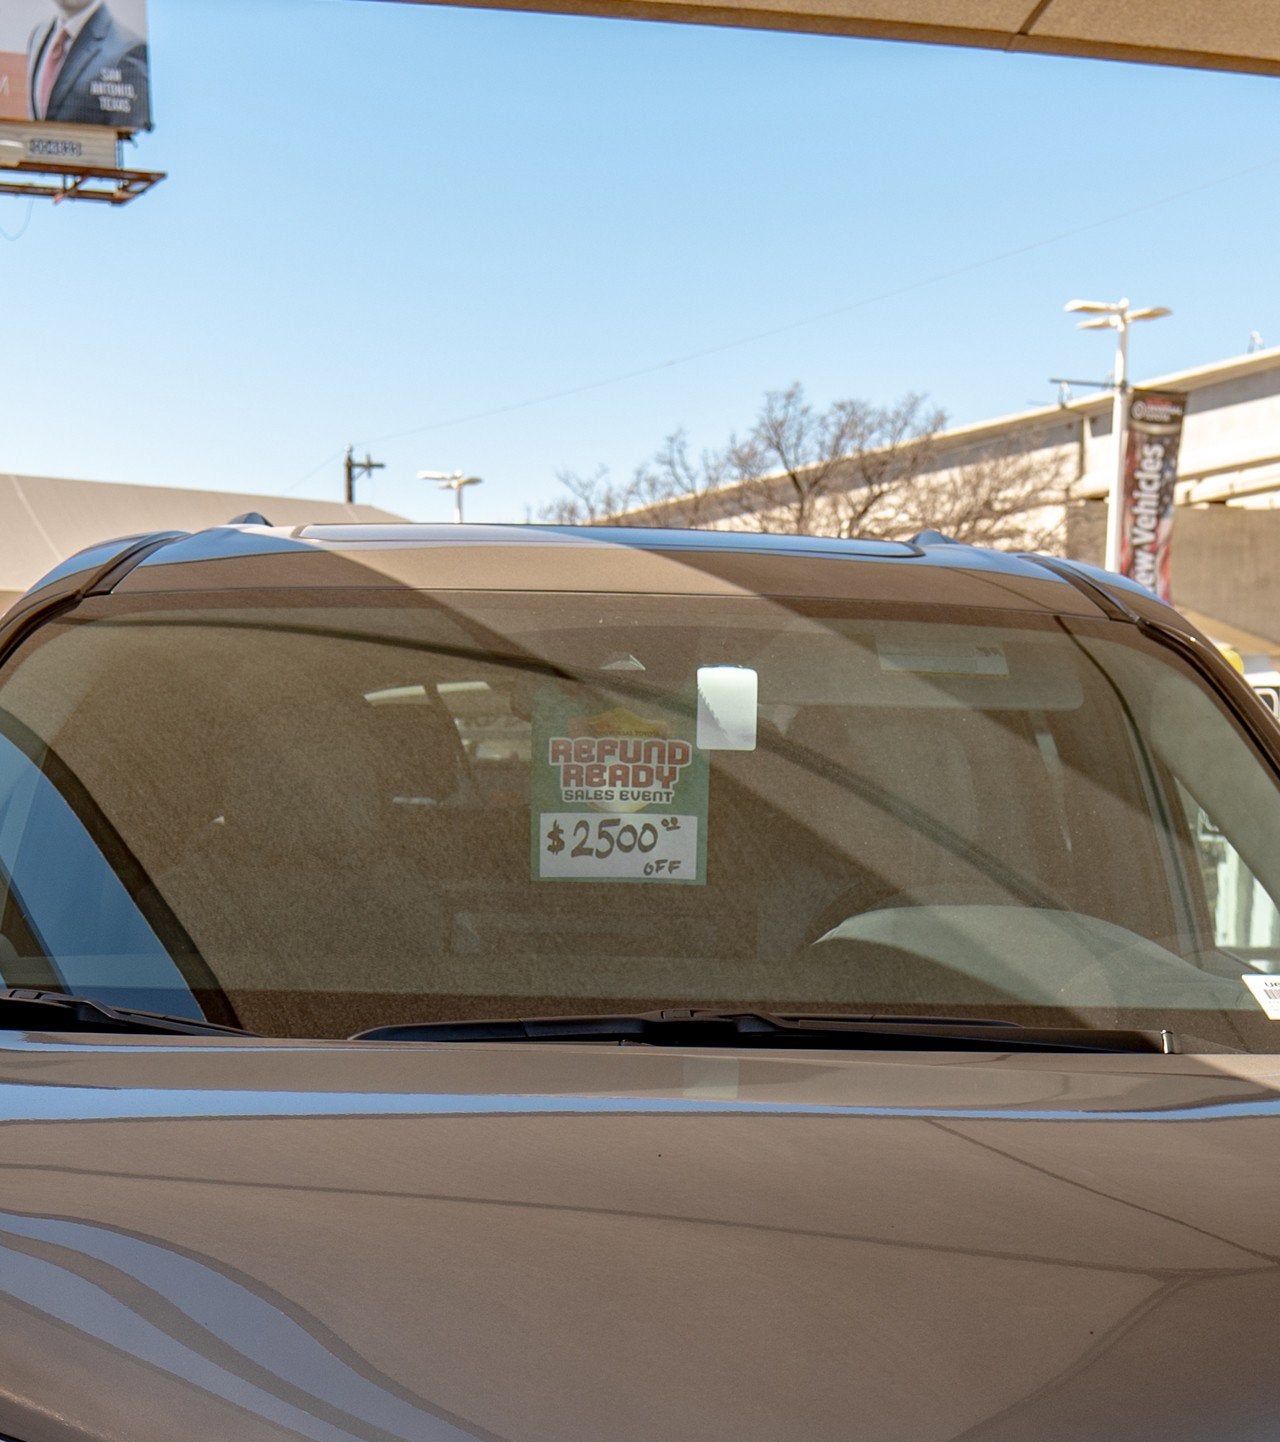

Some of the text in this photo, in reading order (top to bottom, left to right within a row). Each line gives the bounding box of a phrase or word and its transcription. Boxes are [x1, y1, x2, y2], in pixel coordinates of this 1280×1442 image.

[1133, 444, 1165, 544] Vehicles
[1134, 548, 1158, 593] ew
[550, 738, 691, 765] REFUND
[563, 765, 677, 789] READY
[564, 789, 673, 803] SALES EVENT
